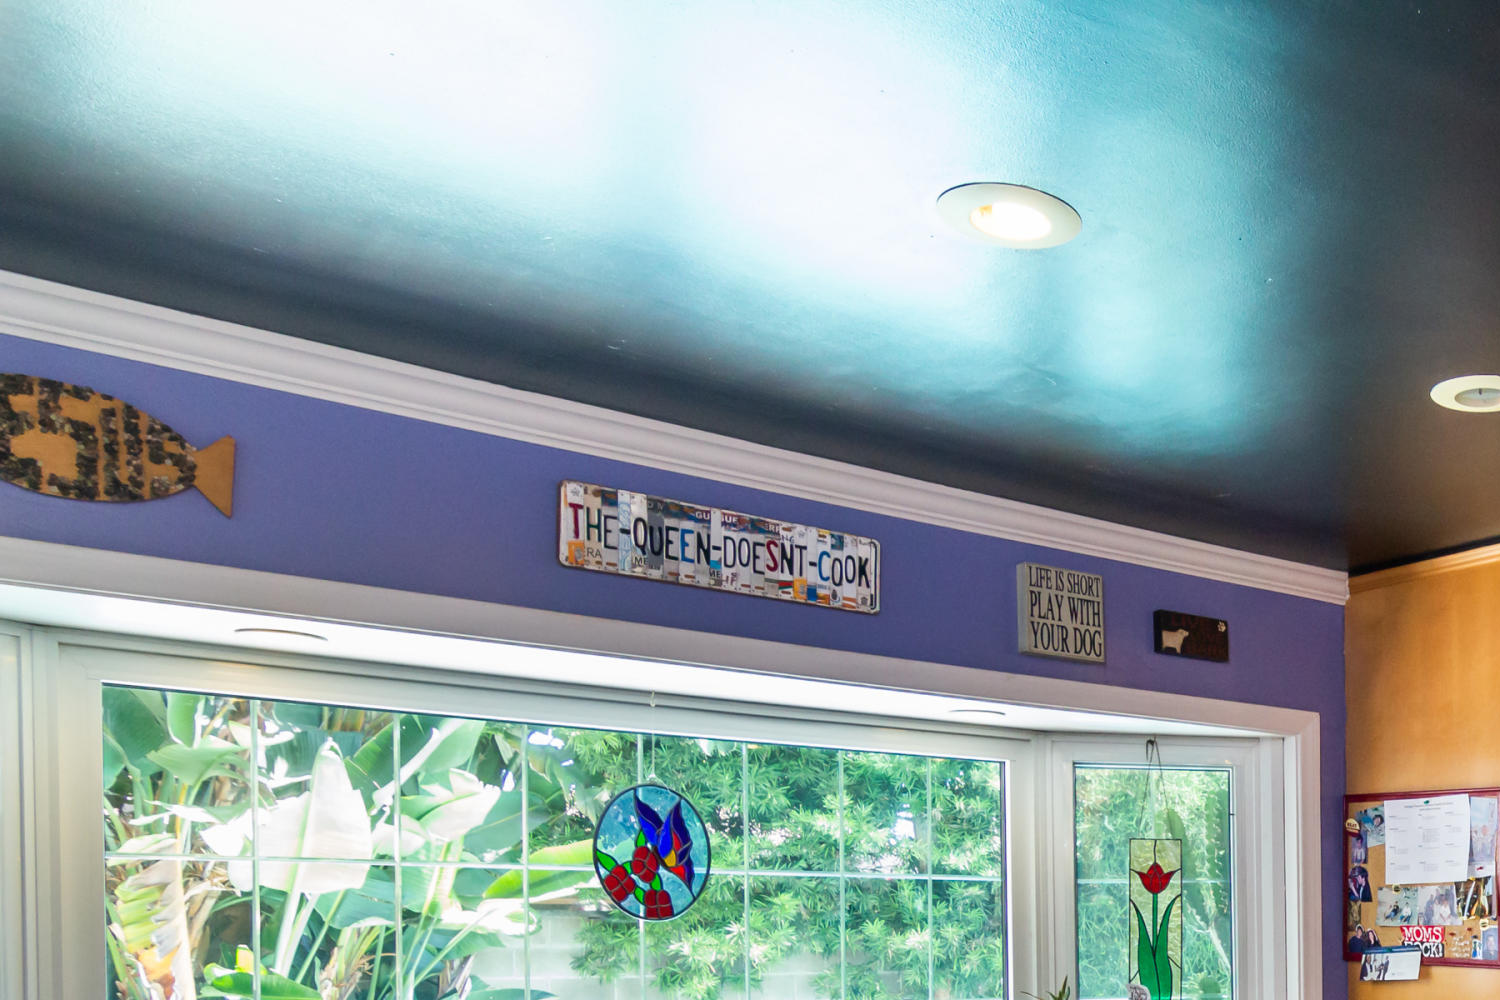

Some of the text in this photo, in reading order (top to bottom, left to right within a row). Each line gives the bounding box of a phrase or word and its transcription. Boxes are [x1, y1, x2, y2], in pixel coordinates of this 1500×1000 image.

[1029, 566, 1100, 598] LIFE IS SHORT
[1029, 590, 1101, 628] PLAY WITH
[1031, 621, 1102, 657] YOUR DOG
[1403, 926, 1443, 943] MOMS
